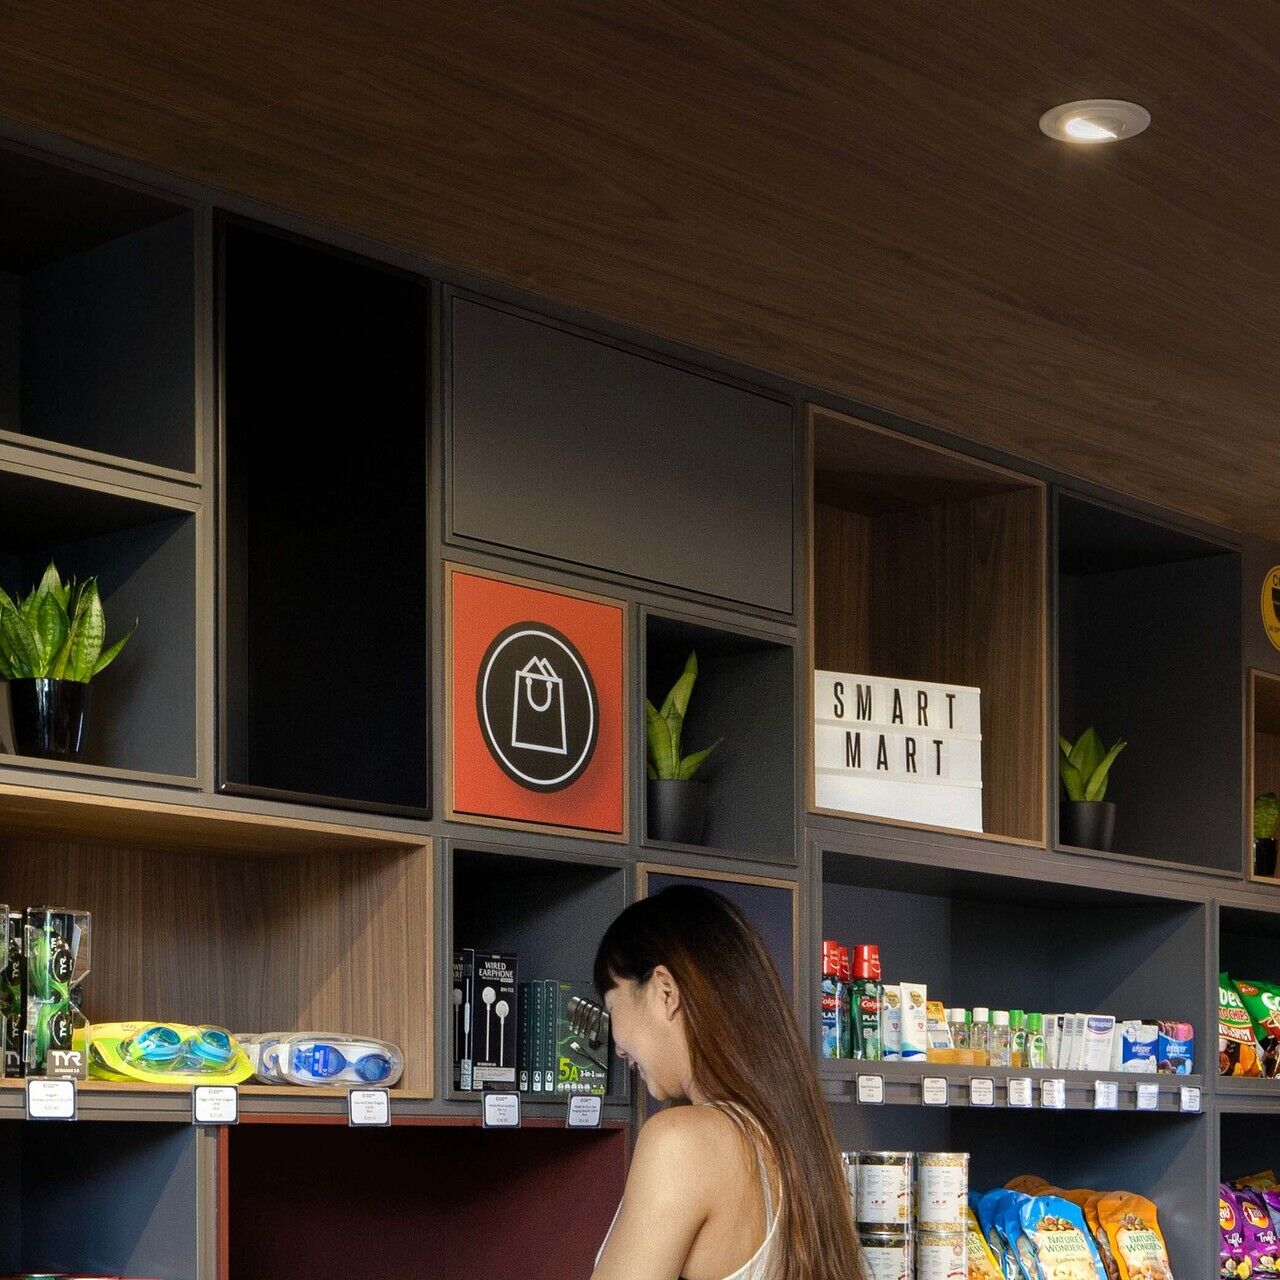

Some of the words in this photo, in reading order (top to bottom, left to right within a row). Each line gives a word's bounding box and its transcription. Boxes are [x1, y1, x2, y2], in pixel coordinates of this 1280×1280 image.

[833, 681, 956, 730] SMART
[845, 731, 944, 776] MART
[484, 961, 506, 970] WIRED
[478, 968, 514, 979] EARPHONE
[1228, 1009, 1250, 1021] CHIPS
[52, 1050, 81, 1066] TYR
[534, 1072, 540, 1081] 6
[546, 1072, 552, 1081] 6
[1047, 1234, 1085, 1245] NATURE'S
[1045, 1243, 1085, 1253] WONDERS
